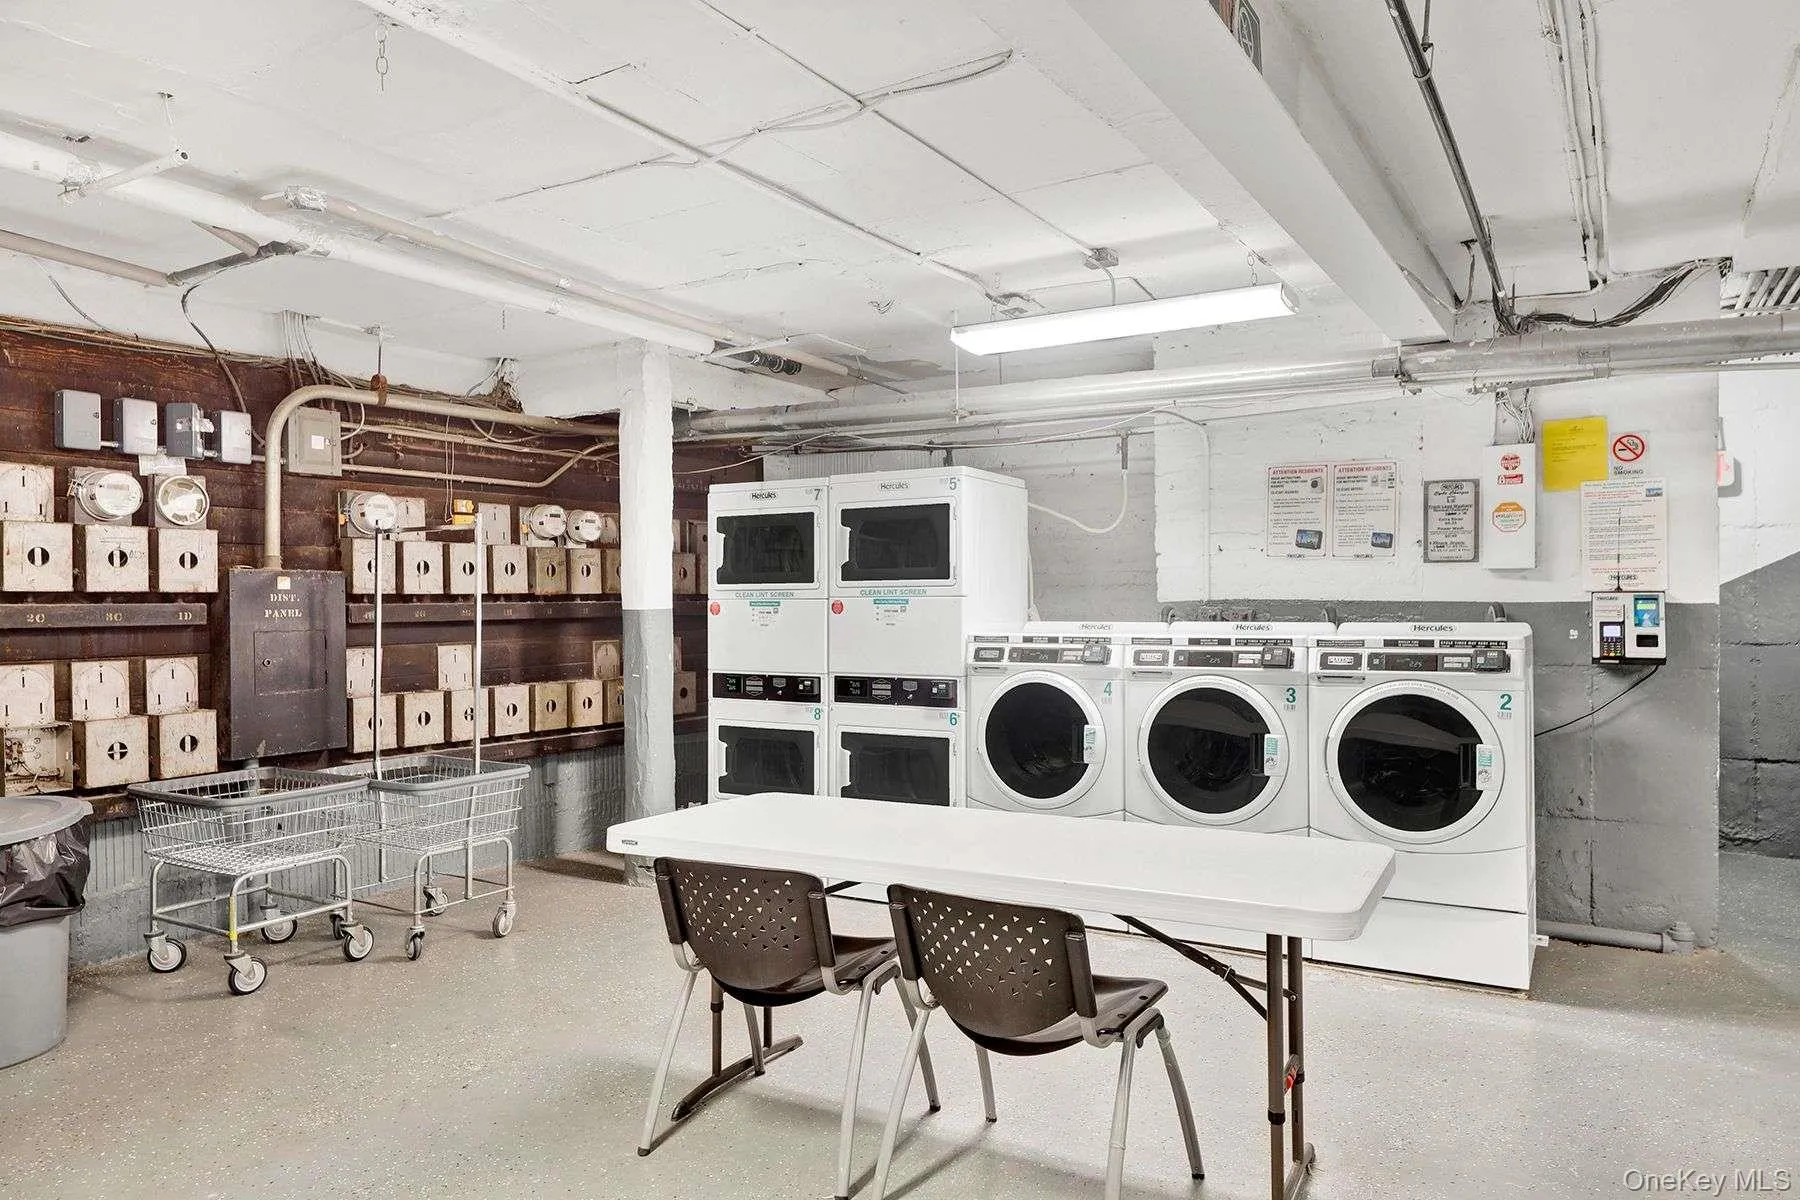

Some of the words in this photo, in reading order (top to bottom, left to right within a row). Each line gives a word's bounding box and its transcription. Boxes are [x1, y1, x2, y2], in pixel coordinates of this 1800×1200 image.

[880, 482, 910, 490] Hercules
[949, 477, 957, 491] 5
[751, 491, 777, 500] Hercules
[814, 488, 821, 501] 7
[270, 593, 300, 602] DIST.
[1081, 623, 1112, 631] Hercules
[1235, 623, 1271, 631] Hercules
[1413, 624, 1454, 632] Hercules
[1103, 681, 1113, 696] 4
[1285, 687, 1296, 703] 3
[1500, 693, 1512, 710] 2
[813, 707, 821, 720] 8
[949, 712, 958, 726] 6
